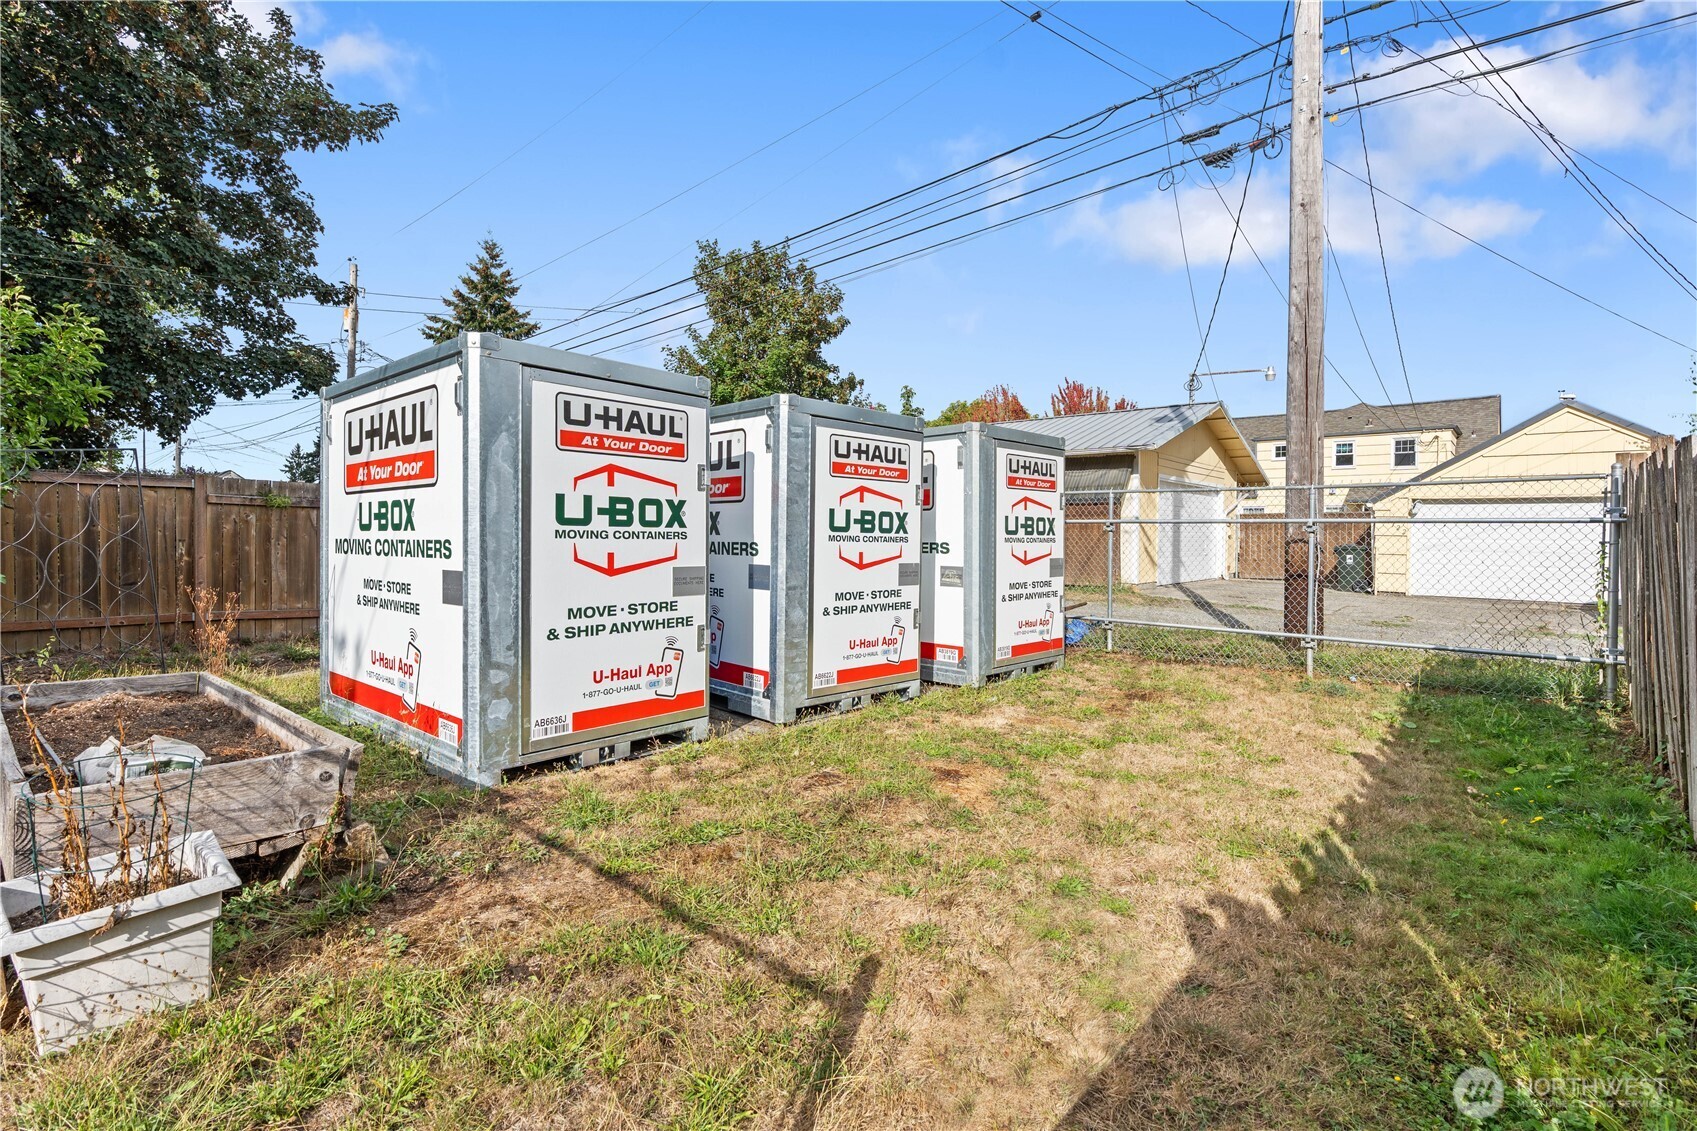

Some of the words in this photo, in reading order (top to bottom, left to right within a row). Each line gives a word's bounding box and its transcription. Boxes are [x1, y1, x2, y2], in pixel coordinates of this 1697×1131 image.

[348, 401, 433, 456] U-HAUL
[563, 400, 683, 439] U-HAUL
[581, 435, 599, 447] At
[603, 438, 635, 450] Your
[639, 441, 672, 454] Door
[834, 439, 907, 465] U-HAUL
[357, 467, 367, 482] At
[369, 464, 393, 480] Your
[394, 461, 423, 477] Door
[844, 465, 855, 473] At
[858, 466, 877, 476] Your
[879, 469, 900, 477] Door
[1008, 458, 1055, 478] U-HAUL
[709, 483, 729, 494] oor
[358, 498, 415, 531] U-BOX
[555, 493, 687, 529] U-BOX
[829, 508, 909, 534] U-BOX
[1005, 515, 1056, 536] U-BOX
[554, 529, 609, 539] MOVING
[613, 530, 688, 540] CONTAINERS
[828, 534, 860, 542] MOVING
[862, 535, 909, 543] CONTAINERS
[335, 538, 372, 556] MOVING
[374, 538, 452, 560] CONTAINERS
[709, 541, 759, 557] AINERS
[363, 578, 383, 591] MOVE
[386, 581, 412, 595] STORE
[1009, 582, 1028, 590] MOVE
[1031, 580, 1052, 589] STORE
[356, 594, 362, 606] &
[362, 595, 378, 609] SHIP
[378, 599, 420, 616] ANYWHERE
[835, 591, 865, 602] MOVE
[870, 589, 902, 599] STORE
[1001, 594, 1007, 603] &
[1007, 593, 1024, 602] SHIP
[1024, 590, 1058, 600] ANYWHERE
[567, 605, 617, 620] MOVE
[627, 600, 678, 615] STORE
[822, 607, 831, 616] &
[832, 605, 858, 616] SHIP
[859, 601, 912, 614] ANYWHERE
[546, 628, 560, 641] &
[564, 623, 606, 639] SHIP
[609, 616, 694, 635] ANYWHERE
[1018, 619, 1038, 629] U-Haul
[1039, 618, 1050, 628] App
[849, 637, 879, 650] U-Haul
[881, 636, 898, 648] App
[371, 650, 396, 671] U-Haul
[398, 658, 414, 679] App
[593, 665, 642, 684] U-Haul
[646, 663, 673, 679] App
[582, 684, 642, 699] 1-877-GO-U-HAUL
[648, 680, 661, 688] GET
[534, 715, 567, 728] AB6636J
